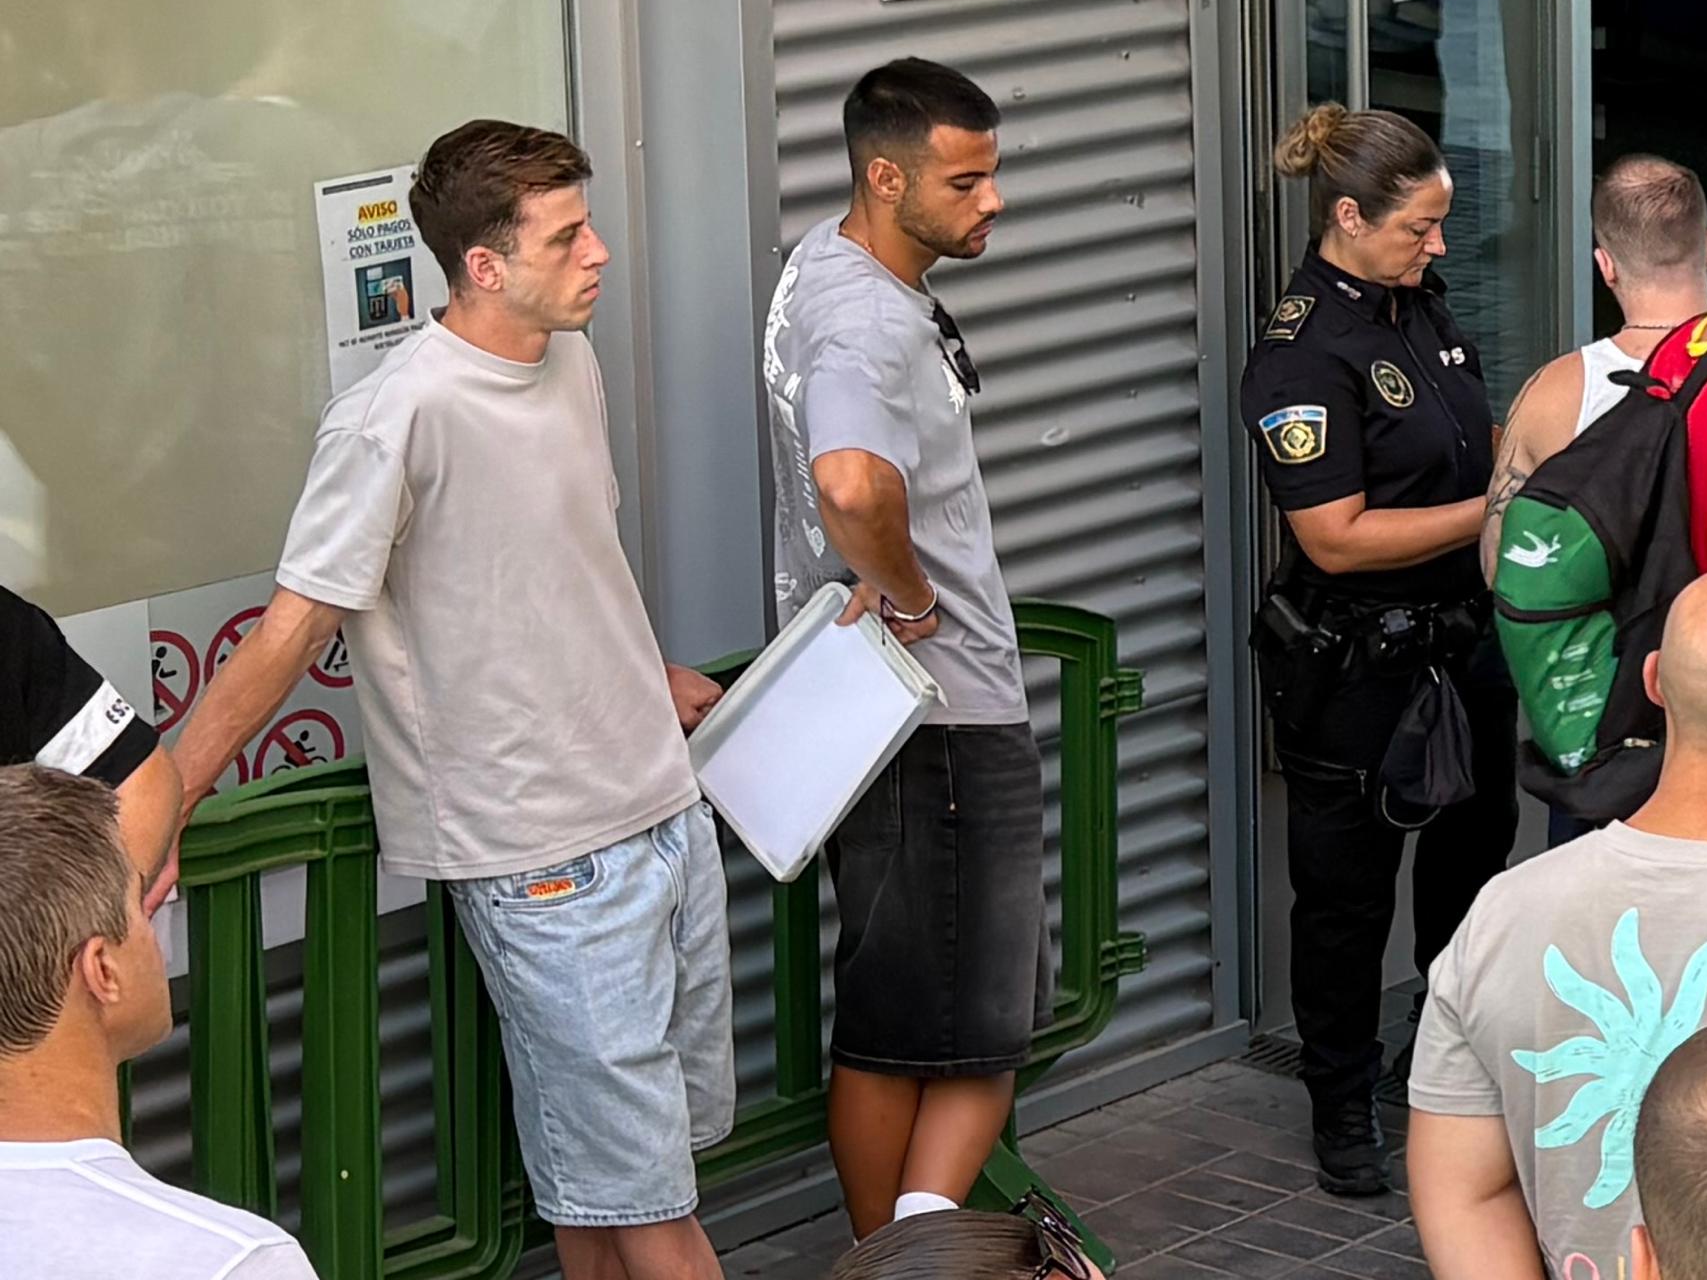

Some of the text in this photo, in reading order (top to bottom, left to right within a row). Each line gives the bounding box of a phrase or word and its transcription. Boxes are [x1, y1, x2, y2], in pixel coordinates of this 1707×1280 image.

[358, 200, 398, 221] AVISO
[347, 218, 412, 242] SÓLO PAGOS
[349, 235, 415, 259] CON TARJETA
